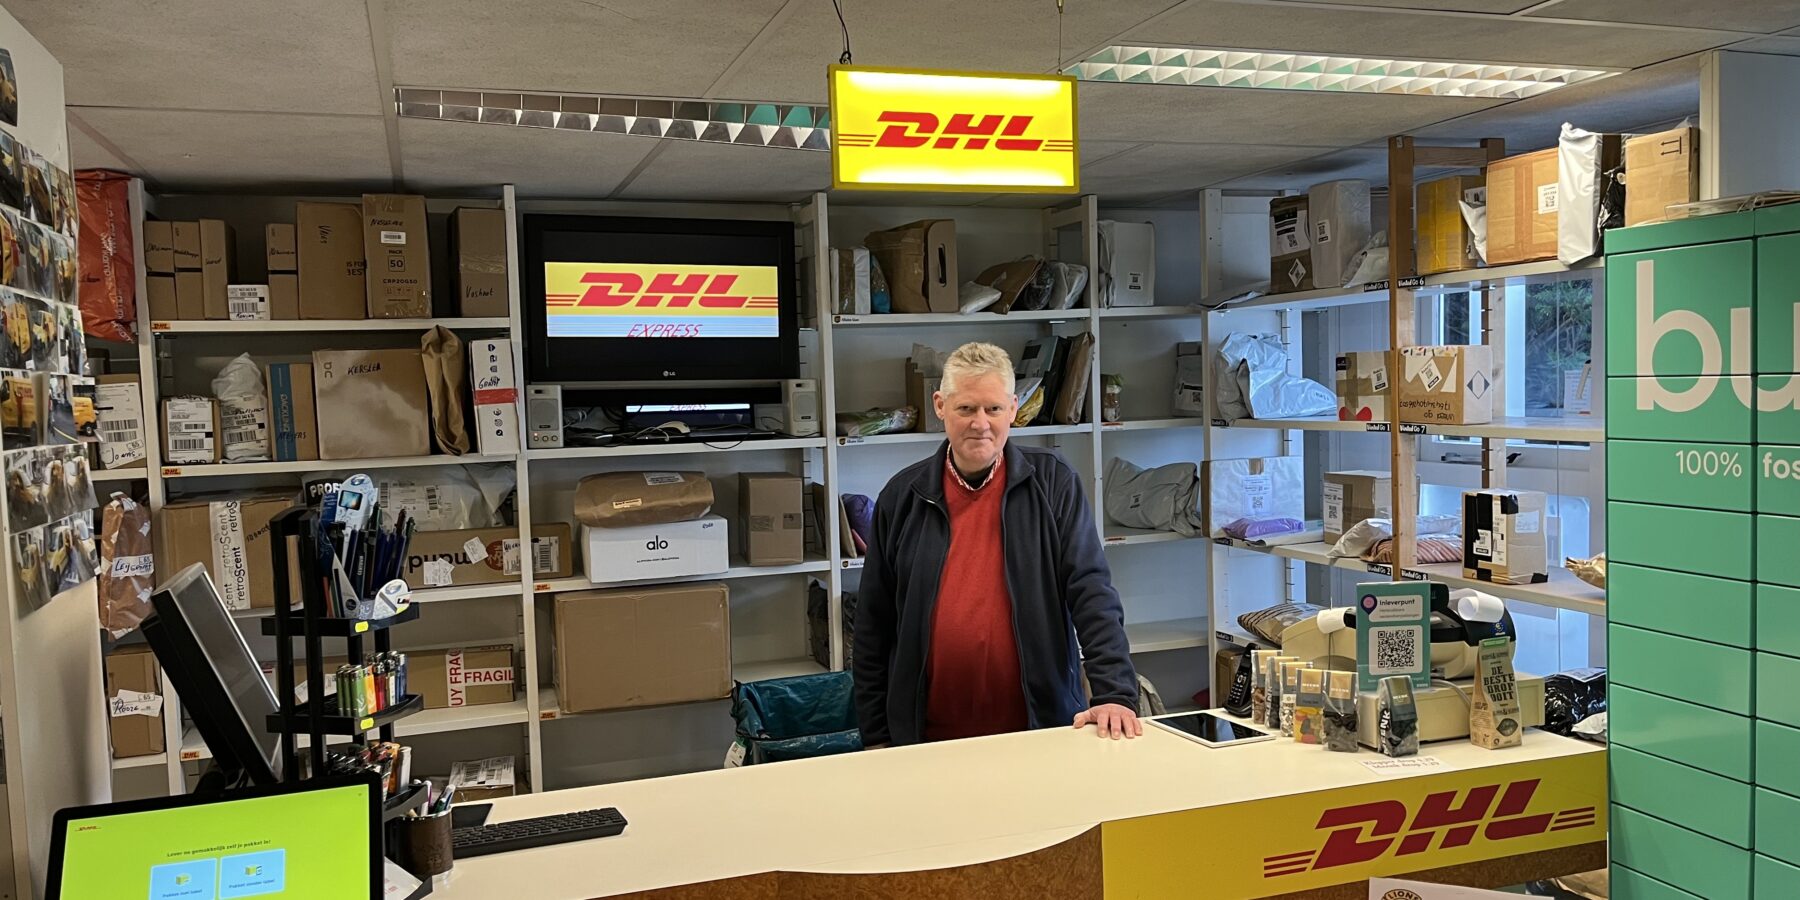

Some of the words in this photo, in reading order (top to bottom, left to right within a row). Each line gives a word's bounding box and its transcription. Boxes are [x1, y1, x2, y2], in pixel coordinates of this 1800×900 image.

[875, 110, 1043, 151] DHL
[390, 260, 404, 268] 50
[577, 272, 748, 309] DHL
[626, 324, 703, 337] EXPRESS
[1636, 260, 1800, 412] bu
[1675, 450, 1742, 478] 100%
[1762, 452, 1800, 480] fos
[310, 482, 343, 498] PROF
[220, 512, 232, 569] retroScent
[646, 534, 668, 551] alo
[232, 546, 246, 601] retroScent
[1379, 599, 1416, 608] Inleverpunt
[1492, 666, 1504, 675] DE
[1484, 674, 1515, 686] BESTE
[1488, 683, 1514, 694] DROP
[451, 690, 464, 706] UY
[1312, 778, 1554, 870] DHL
